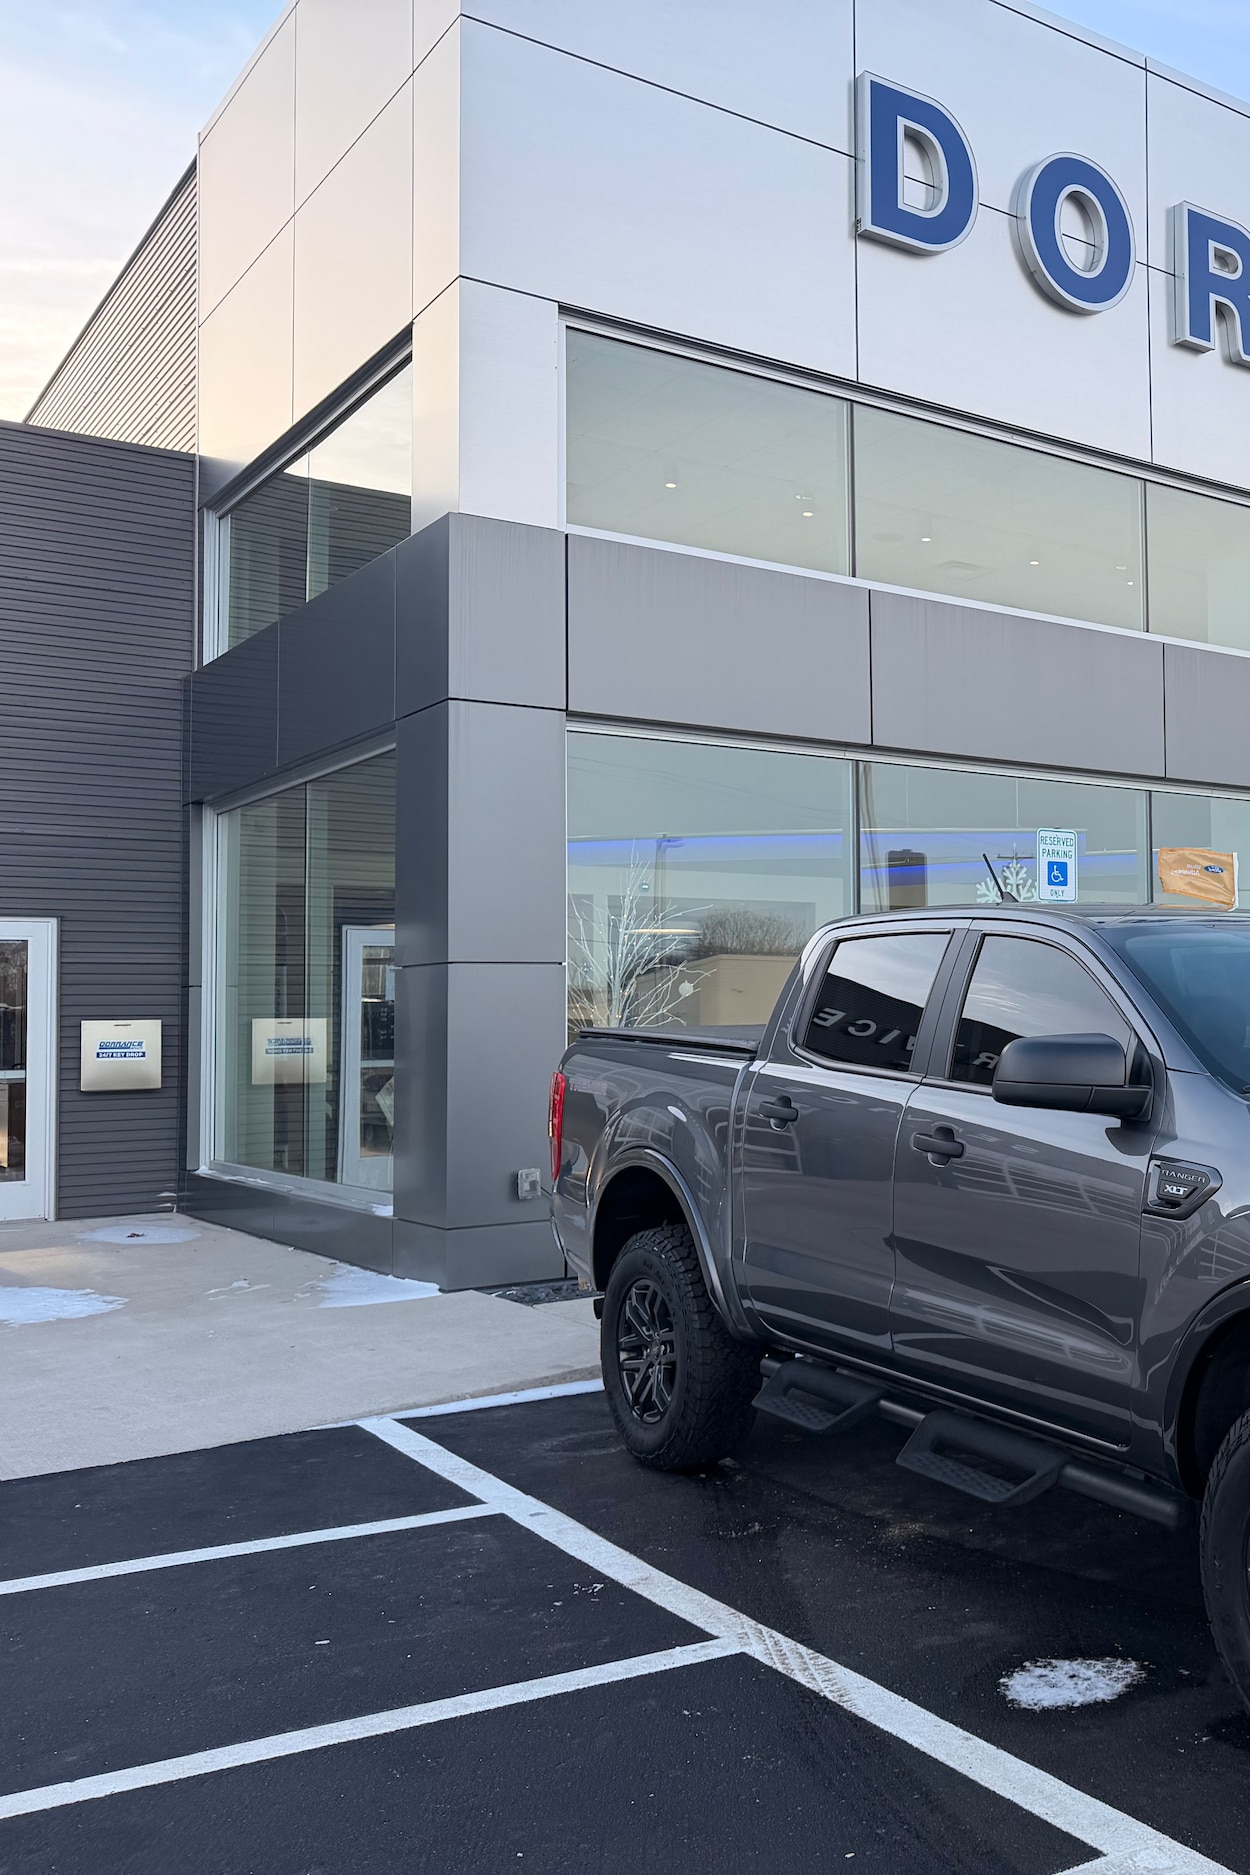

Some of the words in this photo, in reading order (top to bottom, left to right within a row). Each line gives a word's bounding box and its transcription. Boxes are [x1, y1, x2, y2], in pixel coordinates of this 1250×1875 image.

[1040, 835, 1074, 847] RESERVED
[1042, 848, 1073, 859] PARKING
[1050, 889, 1065, 897] ONLY
[1161, 1169, 1206, 1184] RANGER
[1164, 1184, 1188, 1196] XLT
